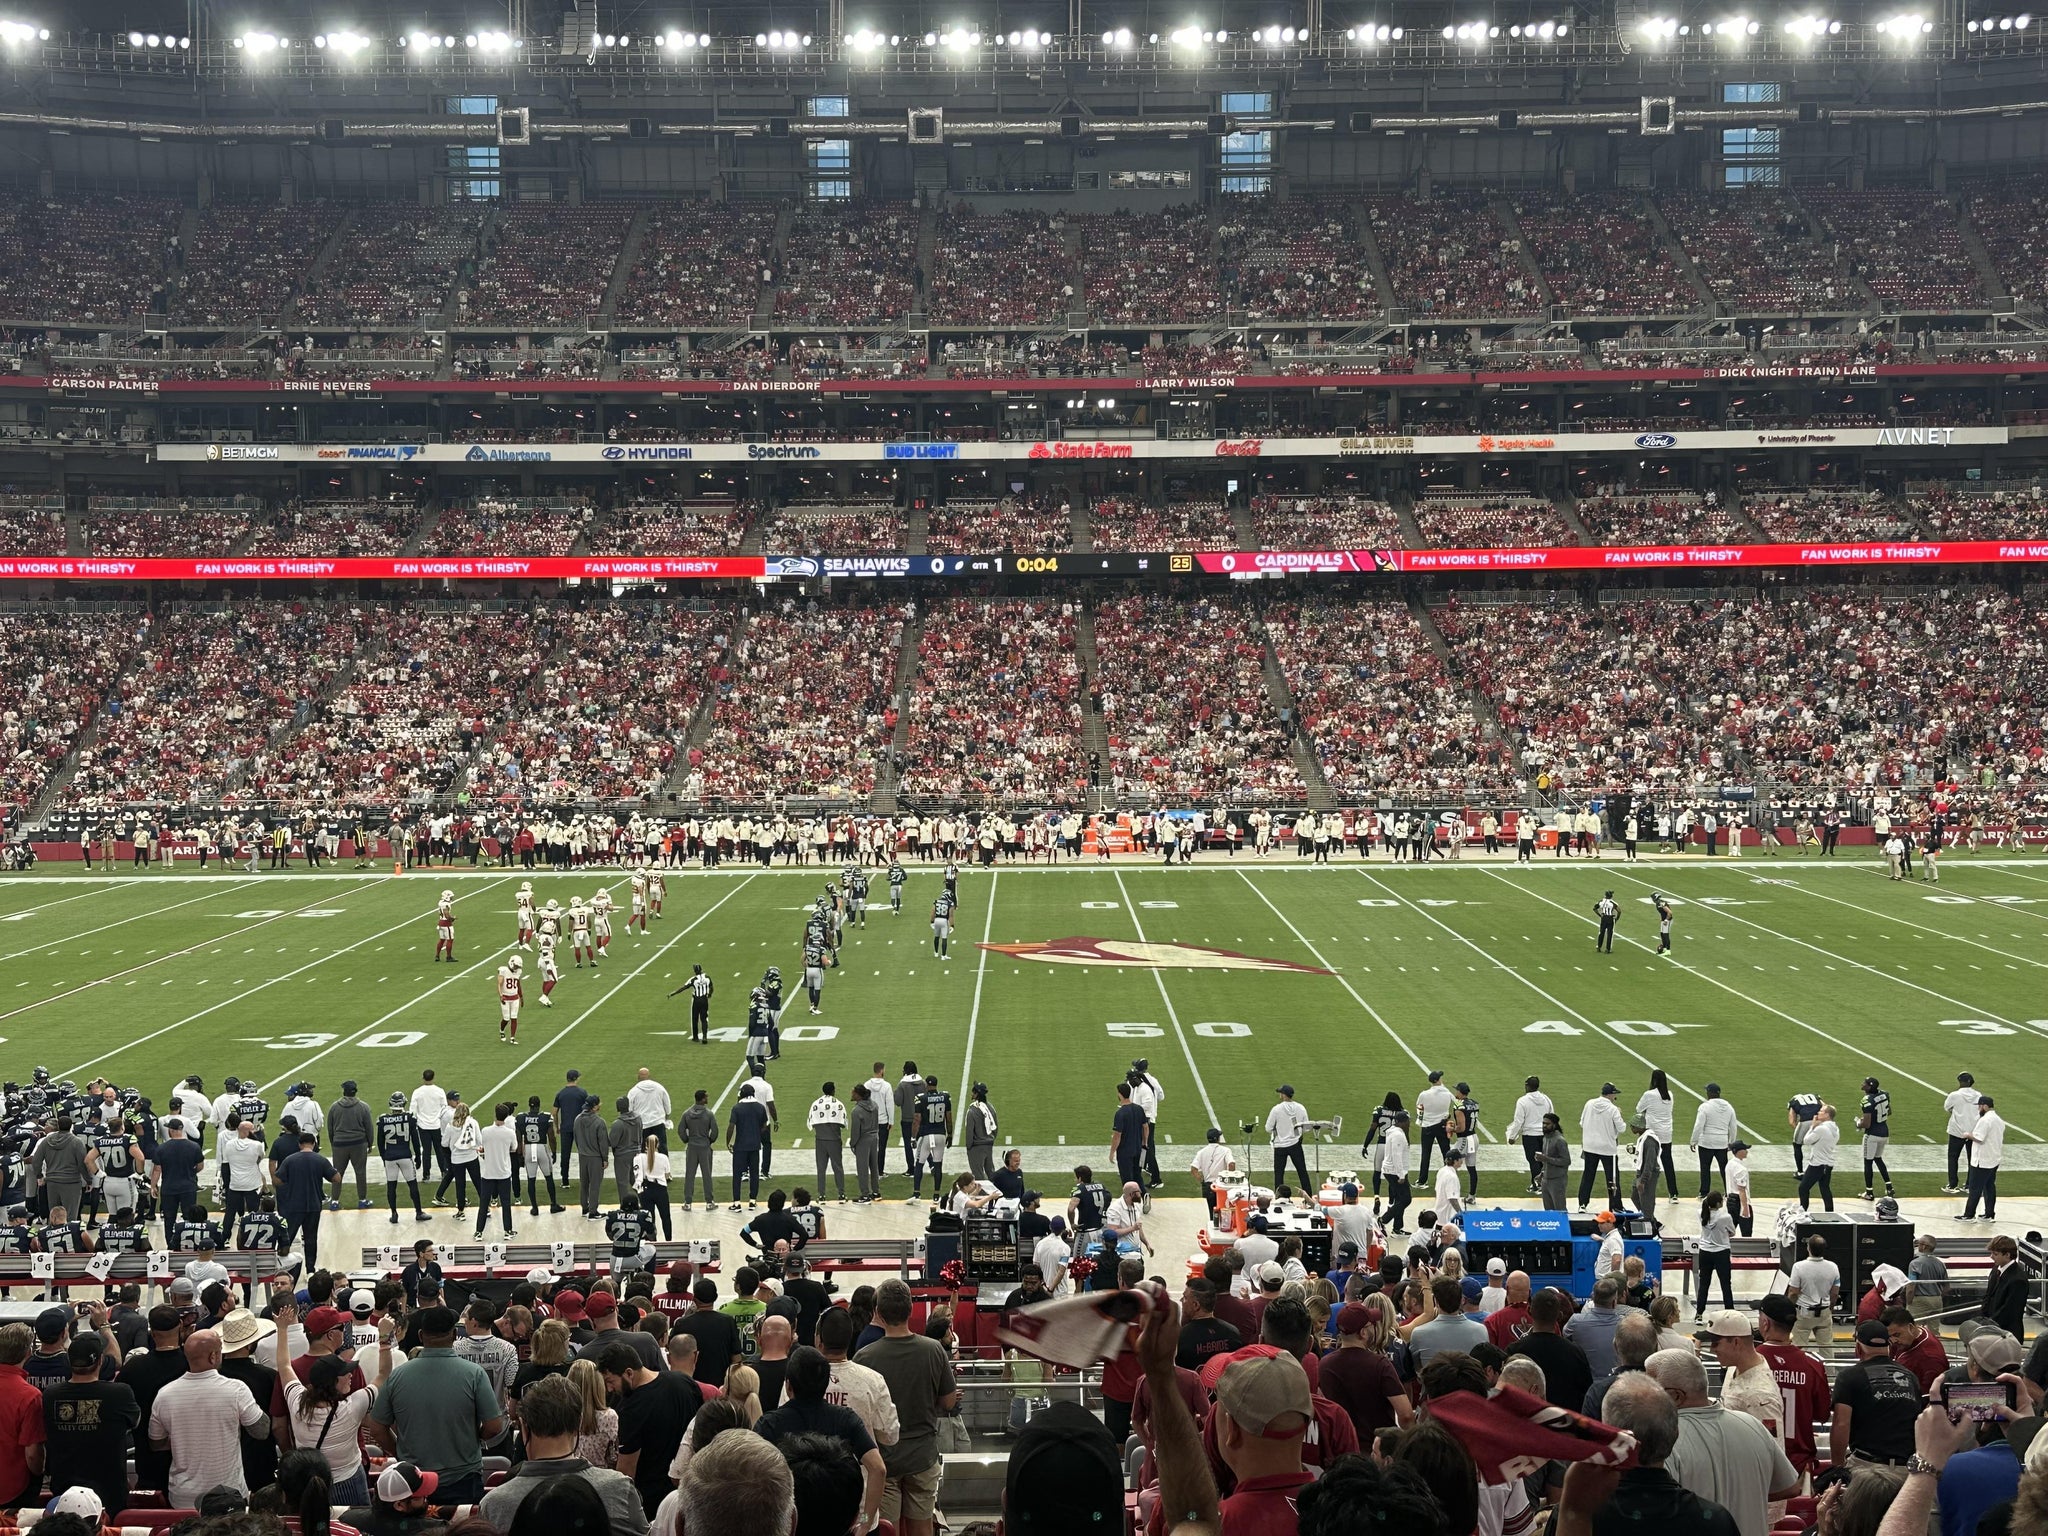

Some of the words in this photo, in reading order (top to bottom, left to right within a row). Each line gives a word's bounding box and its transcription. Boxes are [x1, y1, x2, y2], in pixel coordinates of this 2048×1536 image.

[1703, 369, 1715, 378] 81
[1719, 369, 1747, 378] DICK
[1751, 367, 1793, 377] (NIGHT
[1797, 366, 1840, 376] TRAIN)
[1843, 366, 1876, 375] LANE
[52, 378, 105, 389] CARSON
[109, 380, 159, 391] PALMER
[268, 382, 280, 391] 11
[284, 382, 320, 391] ERNIE
[323, 382, 371, 391] NEVERS
[718, 382, 730, 391] 72
[733, 382, 758, 391] DAN
[761, 382, 821, 391] DIERDORF
[1145, 379, 1184, 388] LARRY
[1188, 378, 1235, 387] WILSON
[1340, 438, 1371, 449] GILA
[1373, 437, 1414, 448] RIVER
[1644, 436, 1669, 446] Ford
[1768, 435, 1797, 444] University
[1799, 434, 1808, 442] of
[1808, 434, 1836, 442] Phoenix
[1876, 427, 1954, 446] AVNET
[1053, 442, 1092, 458] State
[1094, 442, 1132, 458] Farm
[1215, 440, 1263, 457] Coca-Cola
[1497, 440, 1526, 451] Dignity
[1527, 438, 1555, 449] Health
[222, 447, 279, 459] BETMGM
[318, 449, 347, 459] desert
[347, 447, 396, 459] FINANCIAL
[490, 449, 552, 462] Albertsons
[628, 447, 692, 460] HYUNDAI
[747, 444, 816, 460] Spectrum
[886, 446, 915, 458] BUD
[916, 445, 956, 458] LIGHT
[1605, 553, 1629, 563] FAN
[1632, 552, 1670, 562] WORK
[1673, 551, 1684, 561] IS
[1687, 550, 1742, 561] THIRSTY
[1801, 549, 1826, 560] FAN
[1829, 548, 1868, 559] WORK
[1871, 548, 1882, 558] IS
[1885, 547, 1941, 558] THIRSTY
[1999, 547, 2025, 557] FAN
[823, 558, 909, 571] SEAHAWKS
[930, 558, 944, 574] 0
[972, 562, 989, 570] QTR
[993, 558, 1002, 572] 1
[1016, 557, 1058, 572] 0:04
[1172, 558, 1190, 568] 25
[1221, 556, 1236, 571] 0
[1254, 553, 1344, 568] CARDINALS
[1411, 556, 1436, 566] FAN
[1439, 555, 1476, 565] WORK
[1478, 554, 1489, 564] IS
[1492, 554, 1547, 564] THIRSTY
[17, 564, 58, 574] WORK
[61, 564, 73, 574] IS
[77, 563, 136, 574] THIRSTY
[195, 563, 221, 574] FAN
[223, 563, 261, 574] WORK
[264, 563, 275, 573] IS
[278, 563, 335, 573] THIRSTY
[393, 563, 418, 573] FAN
[421, 563, 459, 573] WORK
[461, 563, 472, 573] IS
[475, 563, 530, 573] THIRSTY
[584, 563, 609, 573] FAN
[612, 563, 648, 573] WORK
[651, 562, 662, 572] IS
[665, 562, 718, 573] THIRSTY
[1105, 1022, 1253, 1038] 50
[1521, 1020, 1677, 1036] 40
[265, 1031, 428, 1049] 30
[926, 1102, 946, 1124] 18
[383, 1122, 410, 1145] 24
[100, 1146, 127, 1169] 70
[251, 1214, 269, 1222] LUCAS
[617, 1212, 638, 1222] WILSON
[244, 1224, 274, 1249] 72
[611, 1222, 641, 1248] 23
[1771, 1369, 1806, 1386] GERALD
[826, 1392, 849, 1407] OVE
